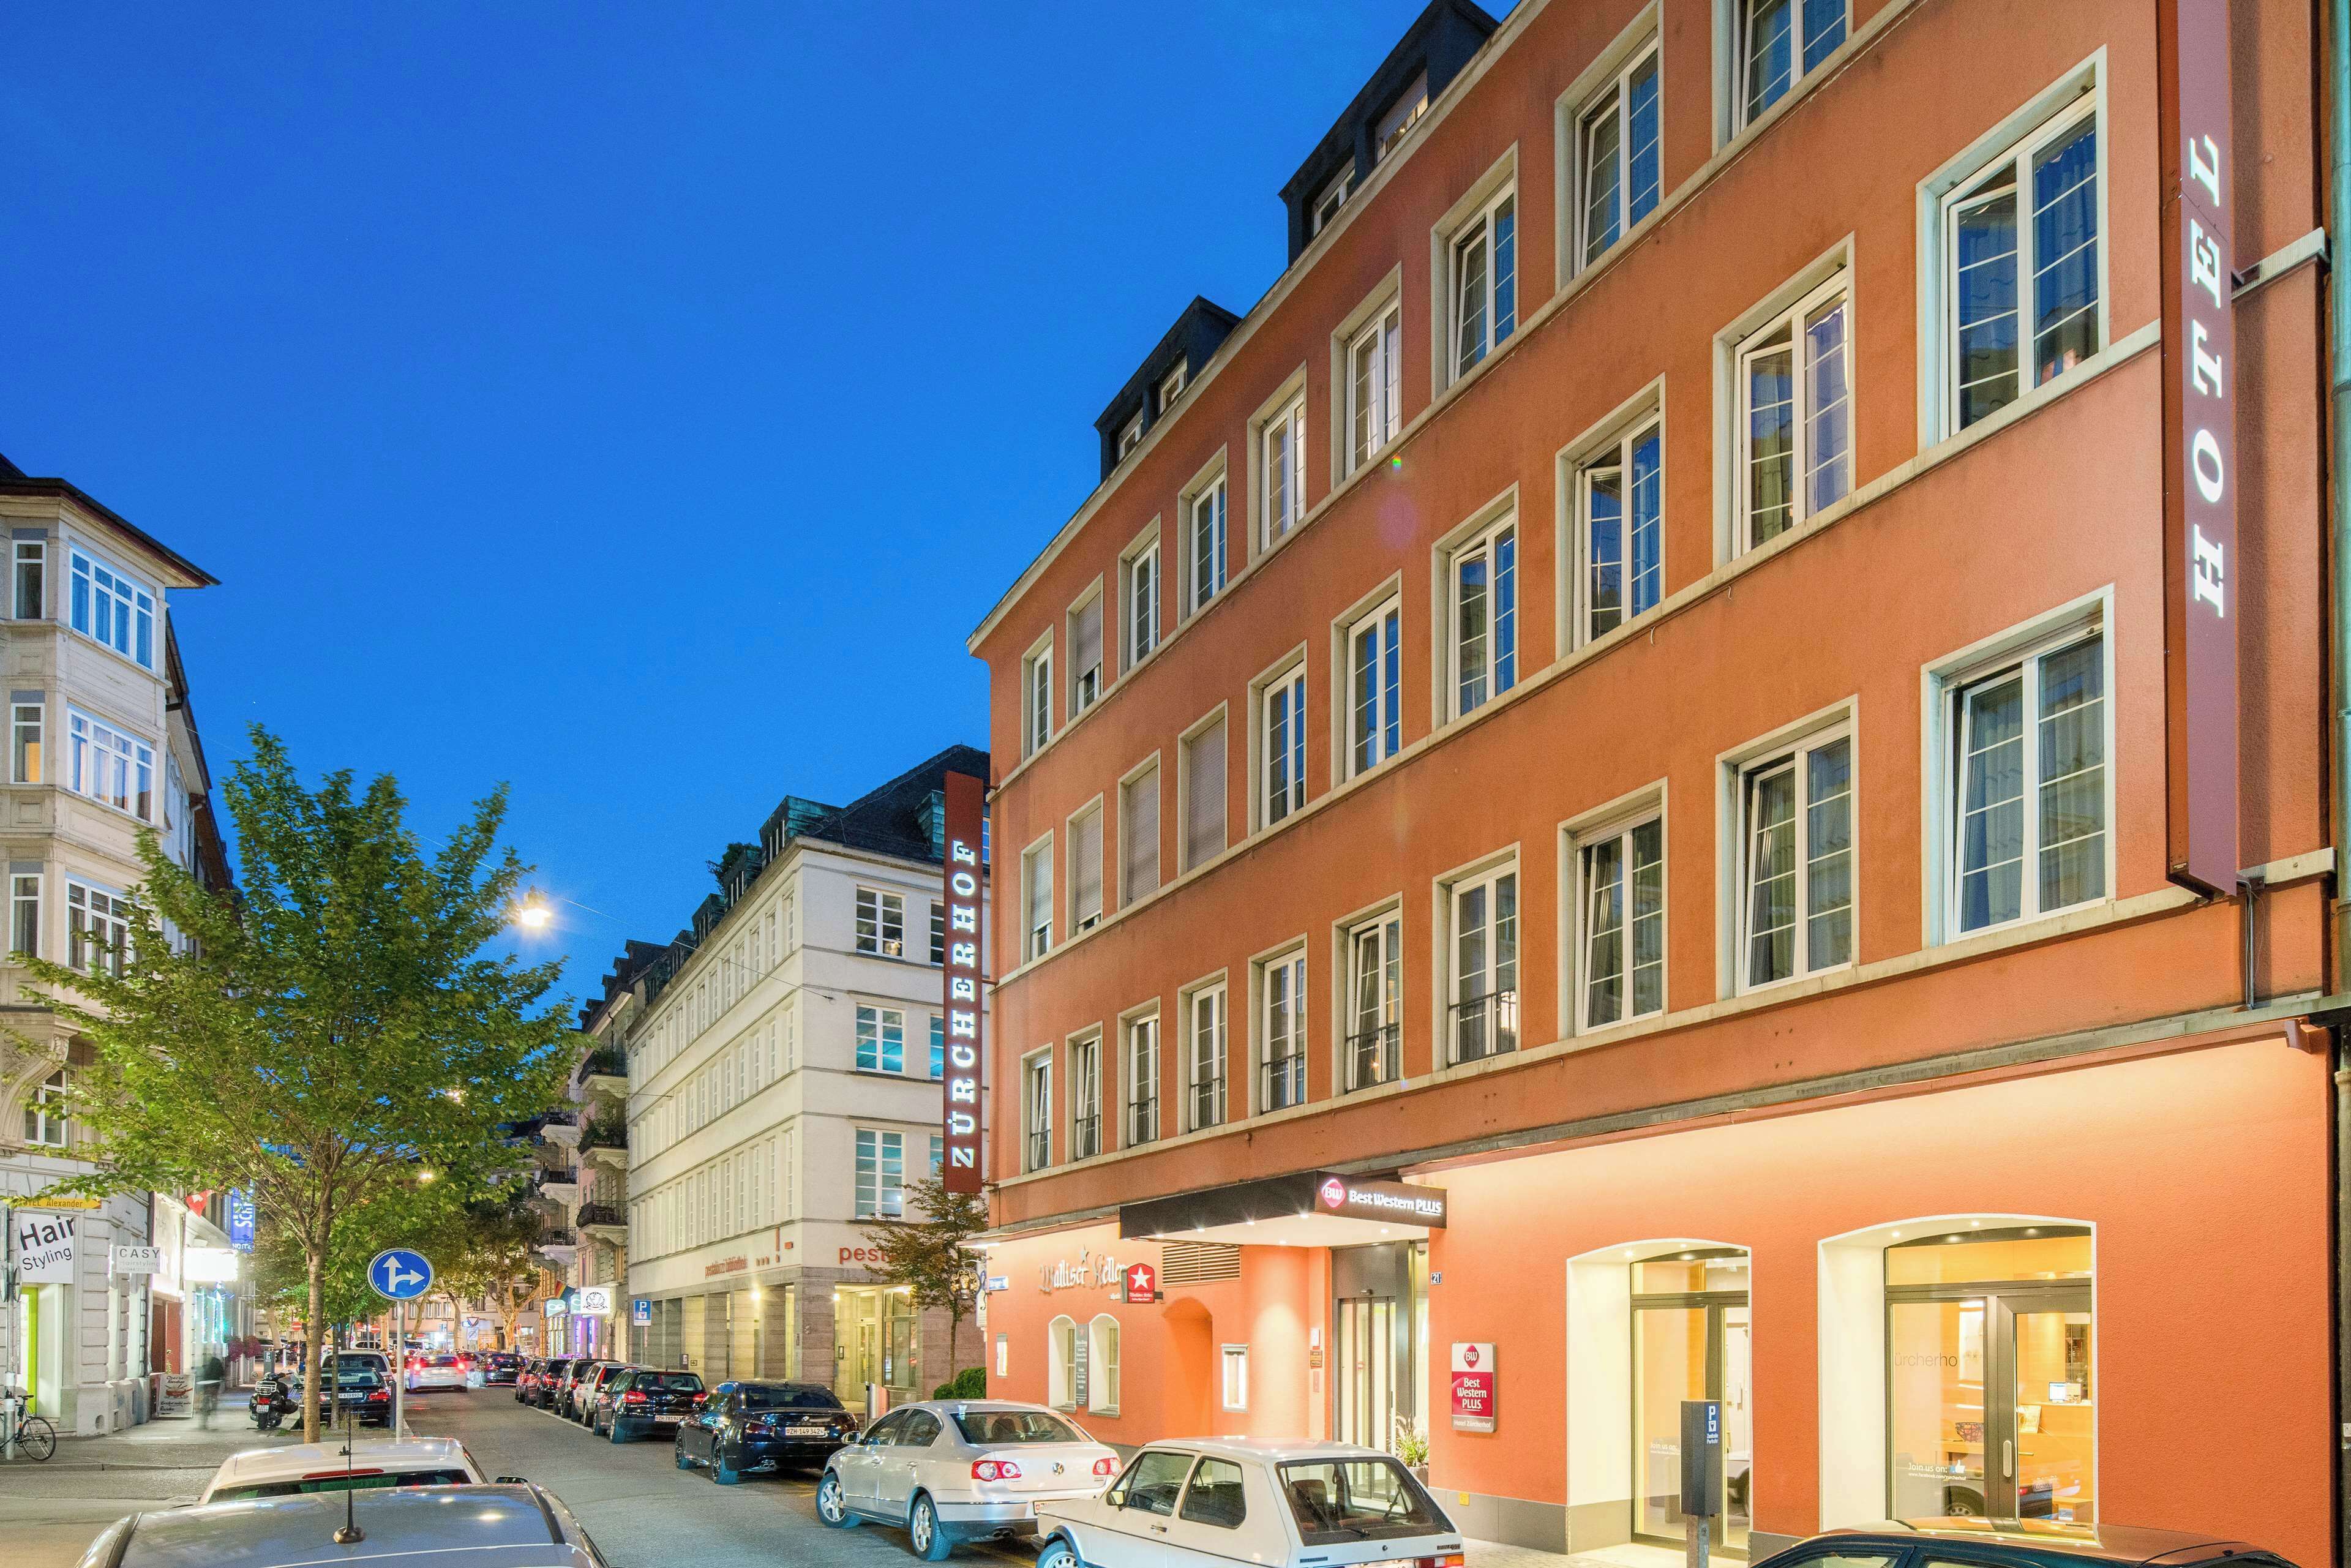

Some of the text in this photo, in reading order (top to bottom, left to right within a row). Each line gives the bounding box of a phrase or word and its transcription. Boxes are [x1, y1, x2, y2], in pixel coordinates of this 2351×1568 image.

[2189, 133, 2224, 618] HOTEL
[1325, 1187, 1343, 1200] BW
[47, 1199, 84, 1208] Alexander
[1349, 1190, 1442, 1214] Best Western PLUS
[20, 1215, 74, 1251] Hair
[22, 1247, 72, 1270] Styling
[119, 1248, 159, 1259] CASY
[1433, 1274, 1440, 1283] 21
[640, 1302, 647, 1311] P
[1465, 1351, 1477, 1362] BW
[1894, 1352, 1958, 1367] ürcherho
[1464, 1377, 1480, 1388] Best
[1457, 1387, 1487, 1398] Western
[1709, 1406, 1716, 1420] P
[1908, 1462, 1924, 1471] Join
